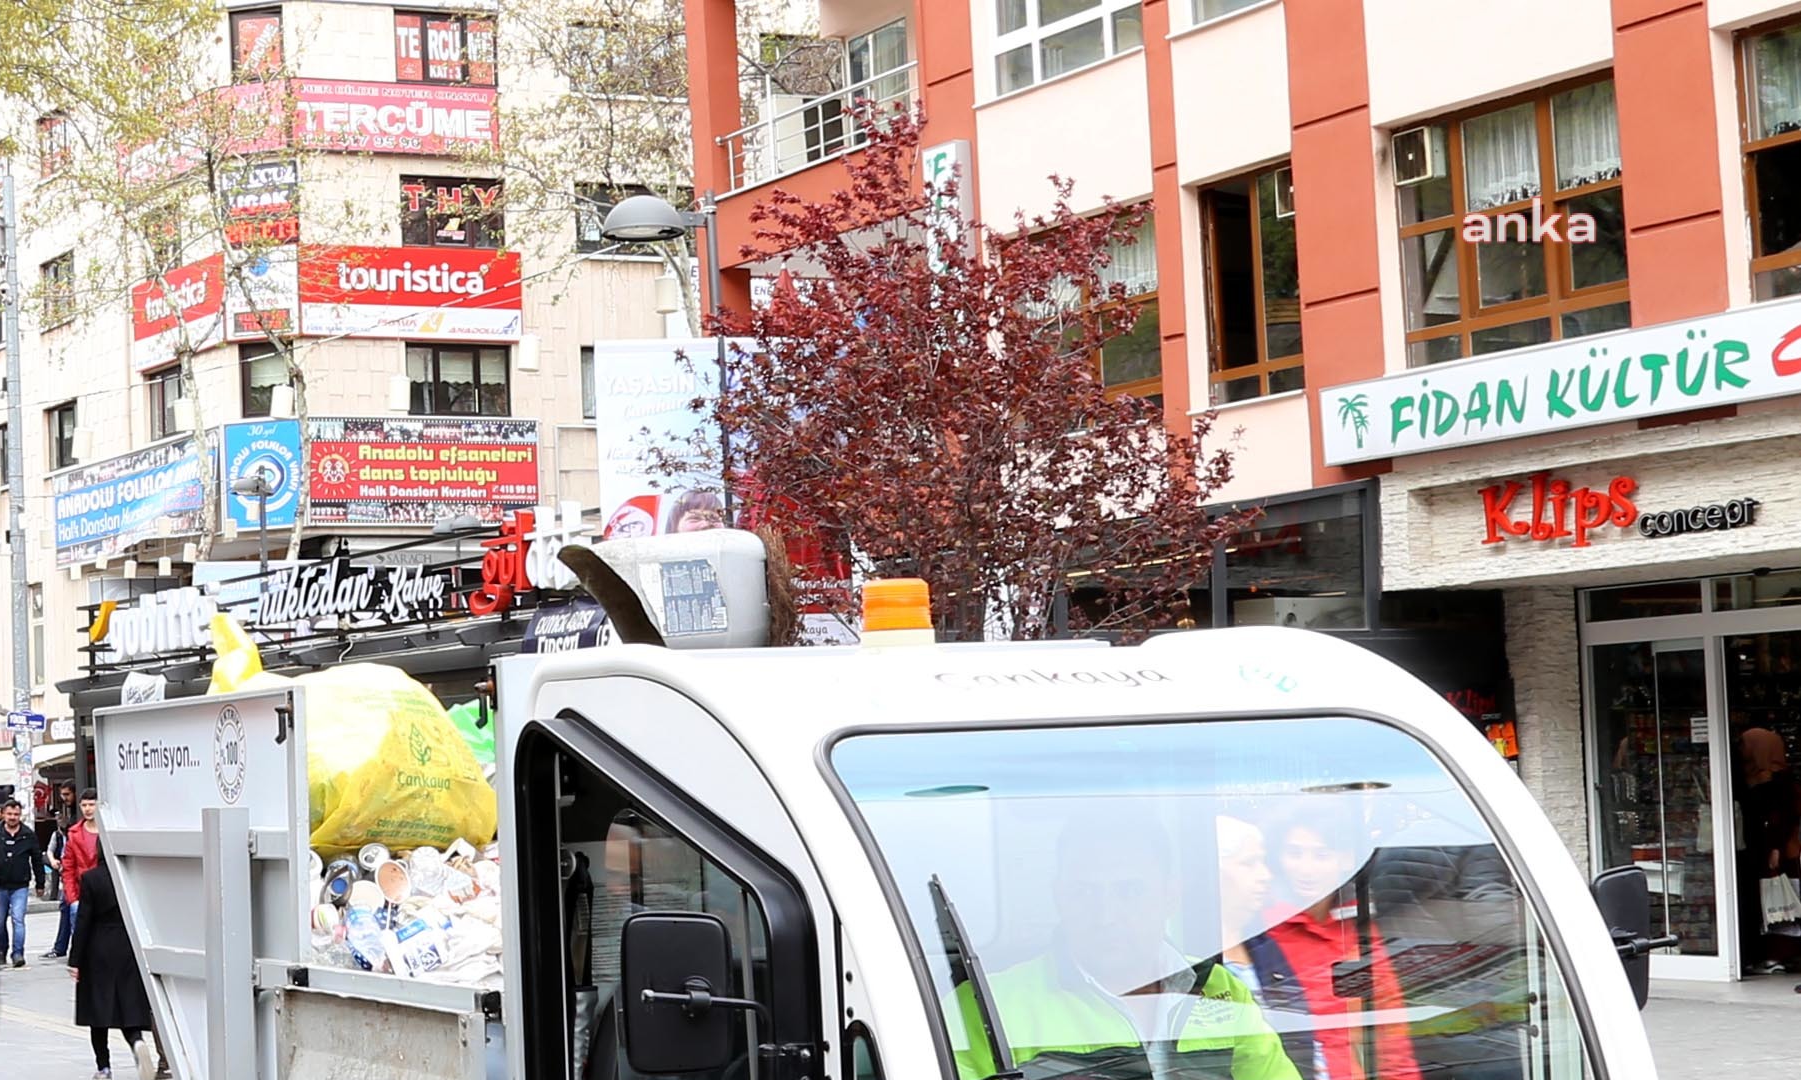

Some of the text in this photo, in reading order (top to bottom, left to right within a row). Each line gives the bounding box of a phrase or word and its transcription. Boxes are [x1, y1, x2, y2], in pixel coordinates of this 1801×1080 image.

[296, 101, 492, 140] TERCÜME
[338, 262, 485, 295] touristica
[1390, 376, 1529, 447] FİDAN
[1546, 328, 1752, 420] KÜLTÜR
[358, 445, 533, 465] Anadolu efsaneleri
[359, 465, 497, 486] dans topluluğu
[359, 485, 387, 498] Halk
[394, 486, 438, 498] Dansları
[441, 486, 487, 498] Kursları
[57, 485, 116, 519] ANADOLU
[1477, 470, 1763, 548] Klips concept
[386, 553, 433, 564] SARACH
[383, 563, 445, 615] Kahve
[118, 742, 139, 771] Sıfır
